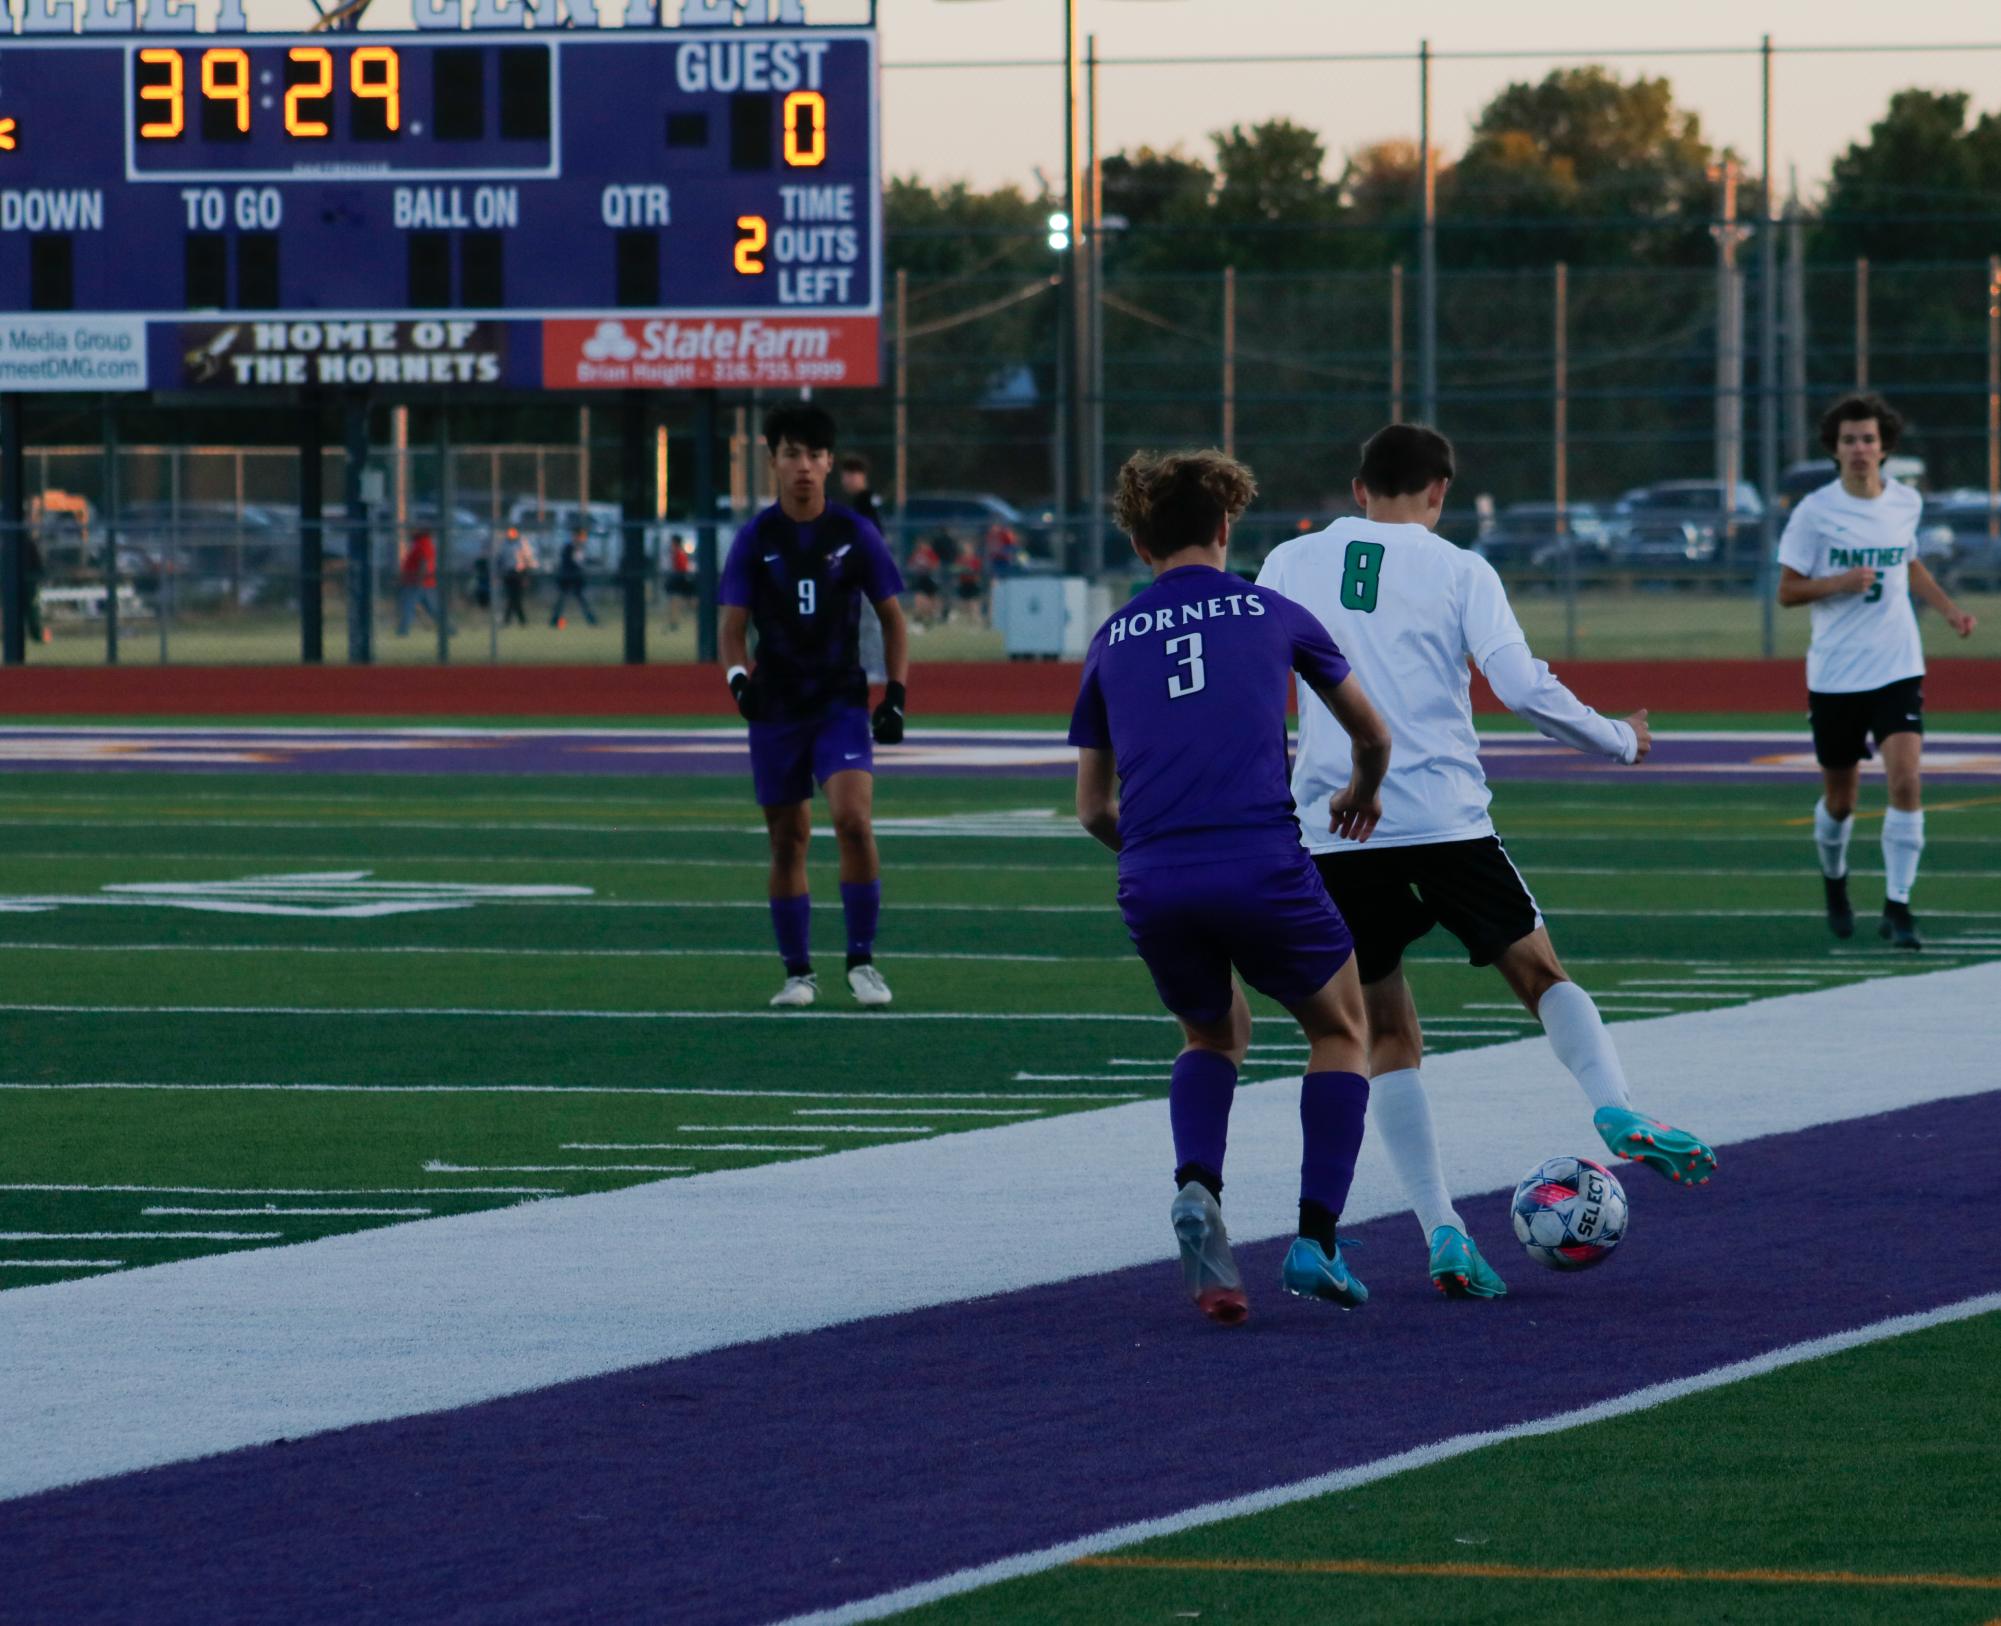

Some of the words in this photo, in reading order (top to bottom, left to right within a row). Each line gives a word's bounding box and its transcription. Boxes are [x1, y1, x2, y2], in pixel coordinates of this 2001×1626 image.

[676, 42, 829, 92] GUEST
[140, 47, 400, 138] 39:29
[784, 91, 826, 166] 0
[1, 190, 103, 230] DOWN
[182, 189, 225, 229] TO
[235, 188, 282, 229] GO
[394, 187, 468, 228] BALL
[474, 187, 517, 227] ON
[602, 185, 670, 226] QTR
[780, 186, 852, 220] TIME
[734, 216, 767, 274] 2
[774, 228, 857, 262] OUTS
[778, 269, 851, 303] LEFT
[10, 330, 68, 350] Media
[75, 329, 131, 353] Group
[253, 322, 397, 350] HOME
[412, 321, 476, 350] OF
[231, 354, 306, 384] THE
[318, 352, 499, 384] HORNETS
[577, 362, 627, 382] Brian
[798, 579, 815, 614] 9
[1340, 540, 1386, 614] 8
[1109, 595, 1265, 646] HORNETS
[1166, 632, 1205, 699] 3
[1577, 1174, 1604, 1238] SELECT
